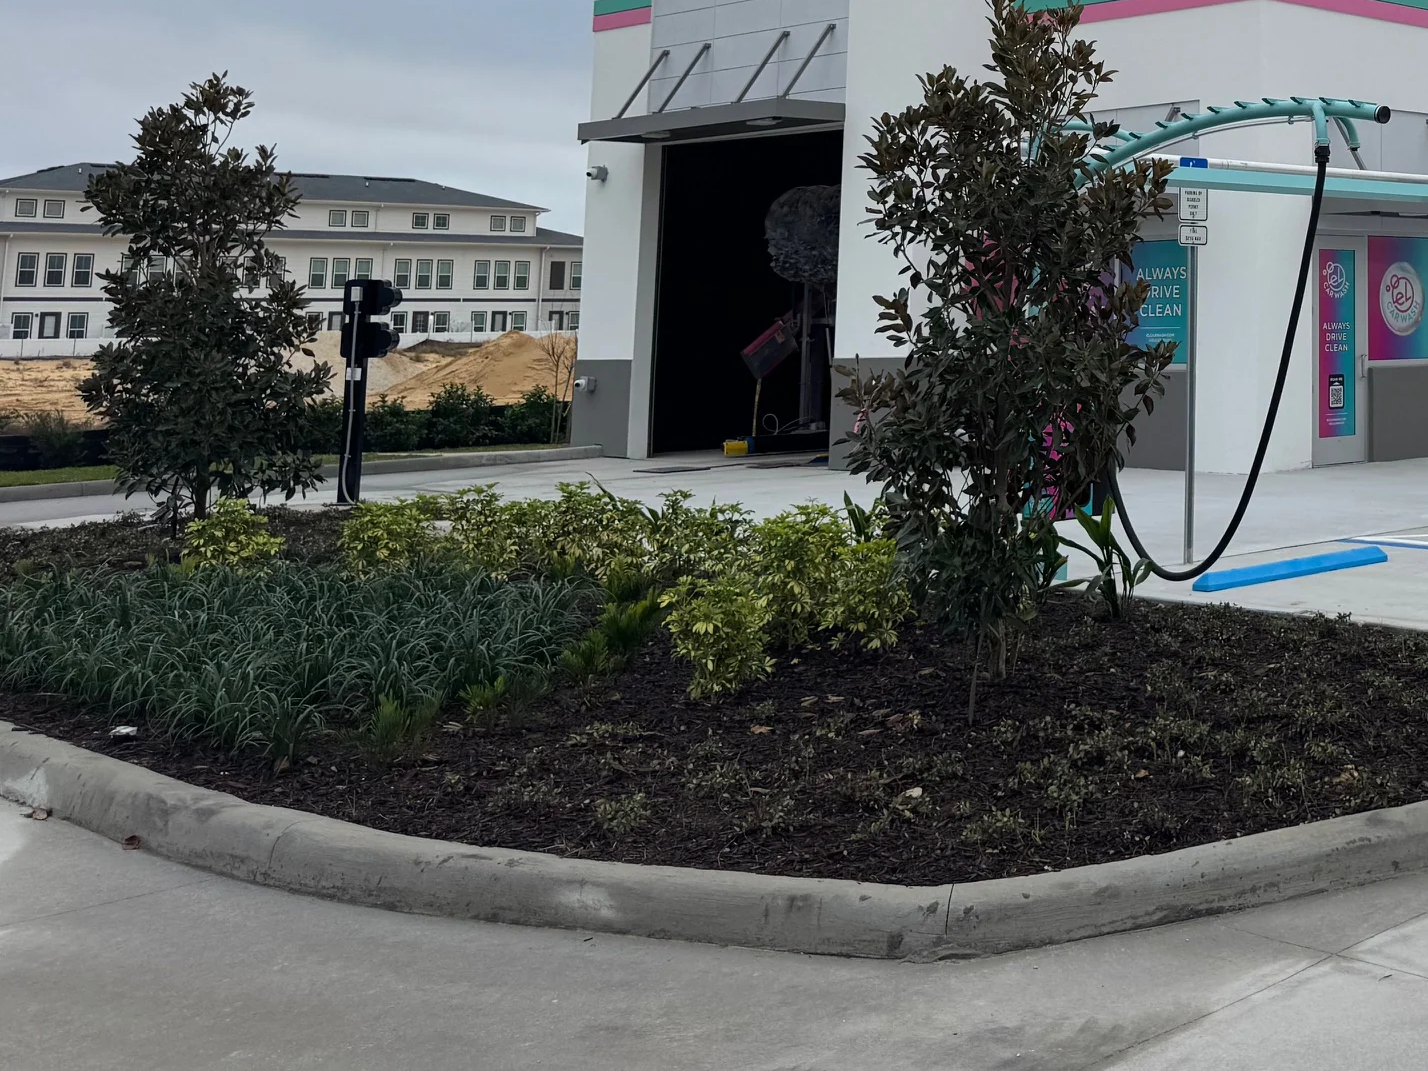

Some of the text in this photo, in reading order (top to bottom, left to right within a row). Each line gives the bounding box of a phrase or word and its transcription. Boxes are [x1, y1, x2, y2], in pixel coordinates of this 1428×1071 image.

[1136, 266, 1187, 280] ALWAYS
[1146, 285, 1180, 298] RIVE
[1139, 304, 1182, 317] CLEAN
[1322, 322, 1351, 330] ALWAYS
[1325, 333, 1347, 341] DRIVE
[1324, 343, 1348, 352] CLEAN
